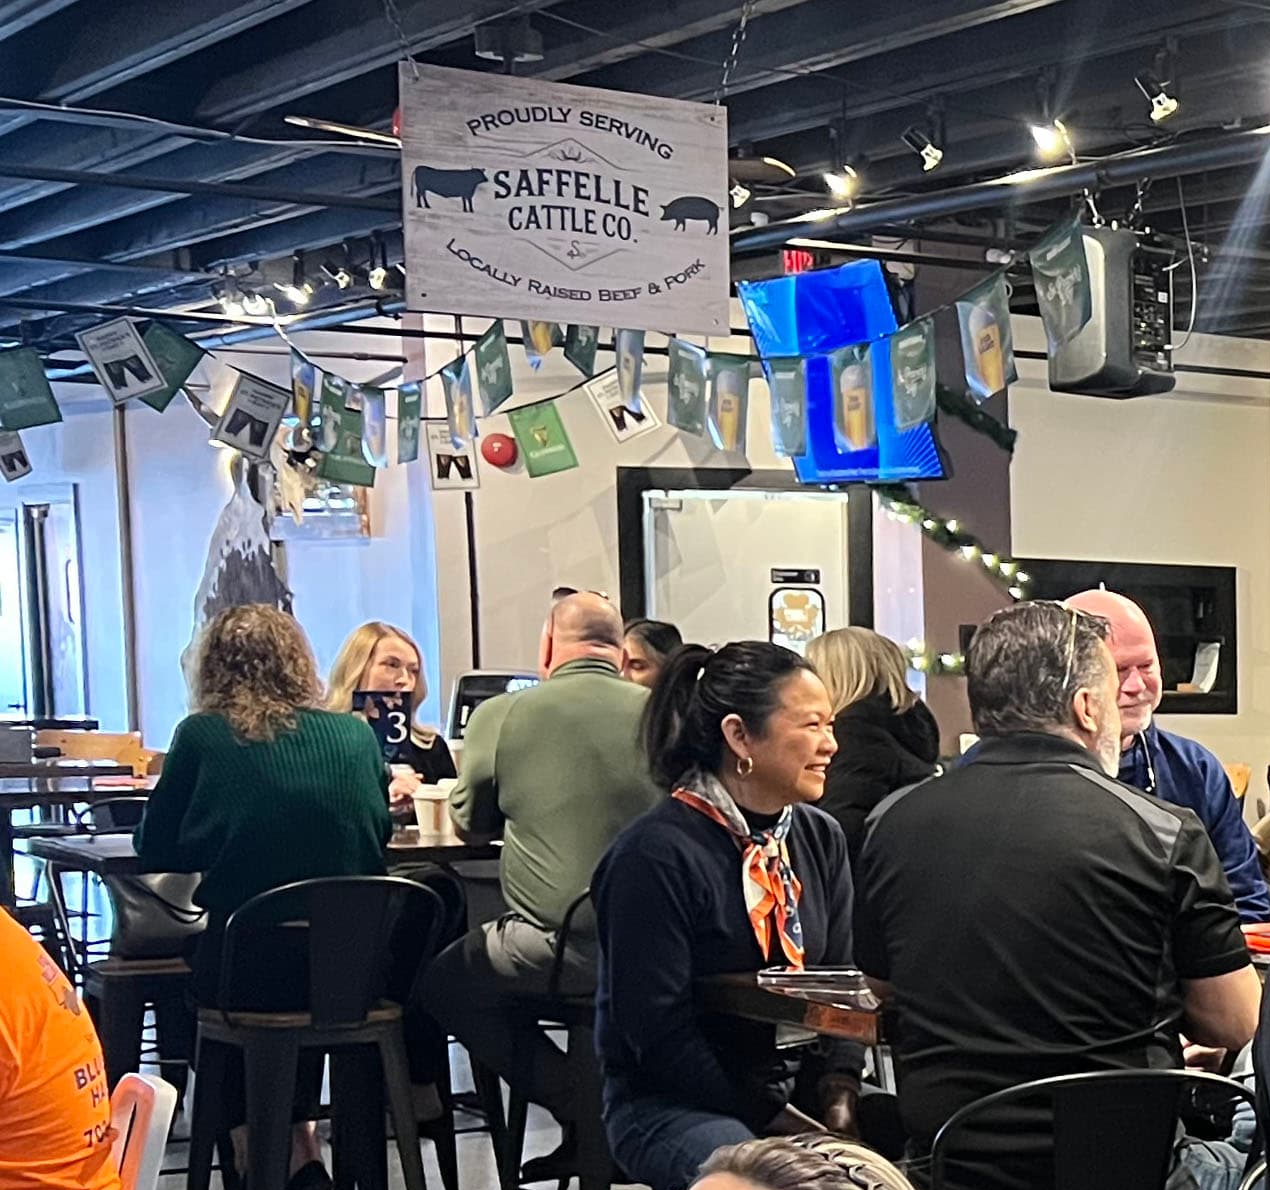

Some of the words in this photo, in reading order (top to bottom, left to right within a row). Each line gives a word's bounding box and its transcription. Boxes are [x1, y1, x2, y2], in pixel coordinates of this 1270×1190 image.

[466, 107, 571, 136] PROUDLY
[579, 111, 674, 160] SERVING
[494, 168, 650, 217] SAFFELLE
[508, 205, 597, 235] CATTLE
[602, 214, 639, 244] CO.
[446, 238, 522, 287] LOCALLY
[527, 279, 592, 302] RAISED
[598, 287, 642, 302] BEEF
[648, 282, 661, 294] &
[664, 258, 706, 290] PORK
[386, 712, 407, 743] 3
